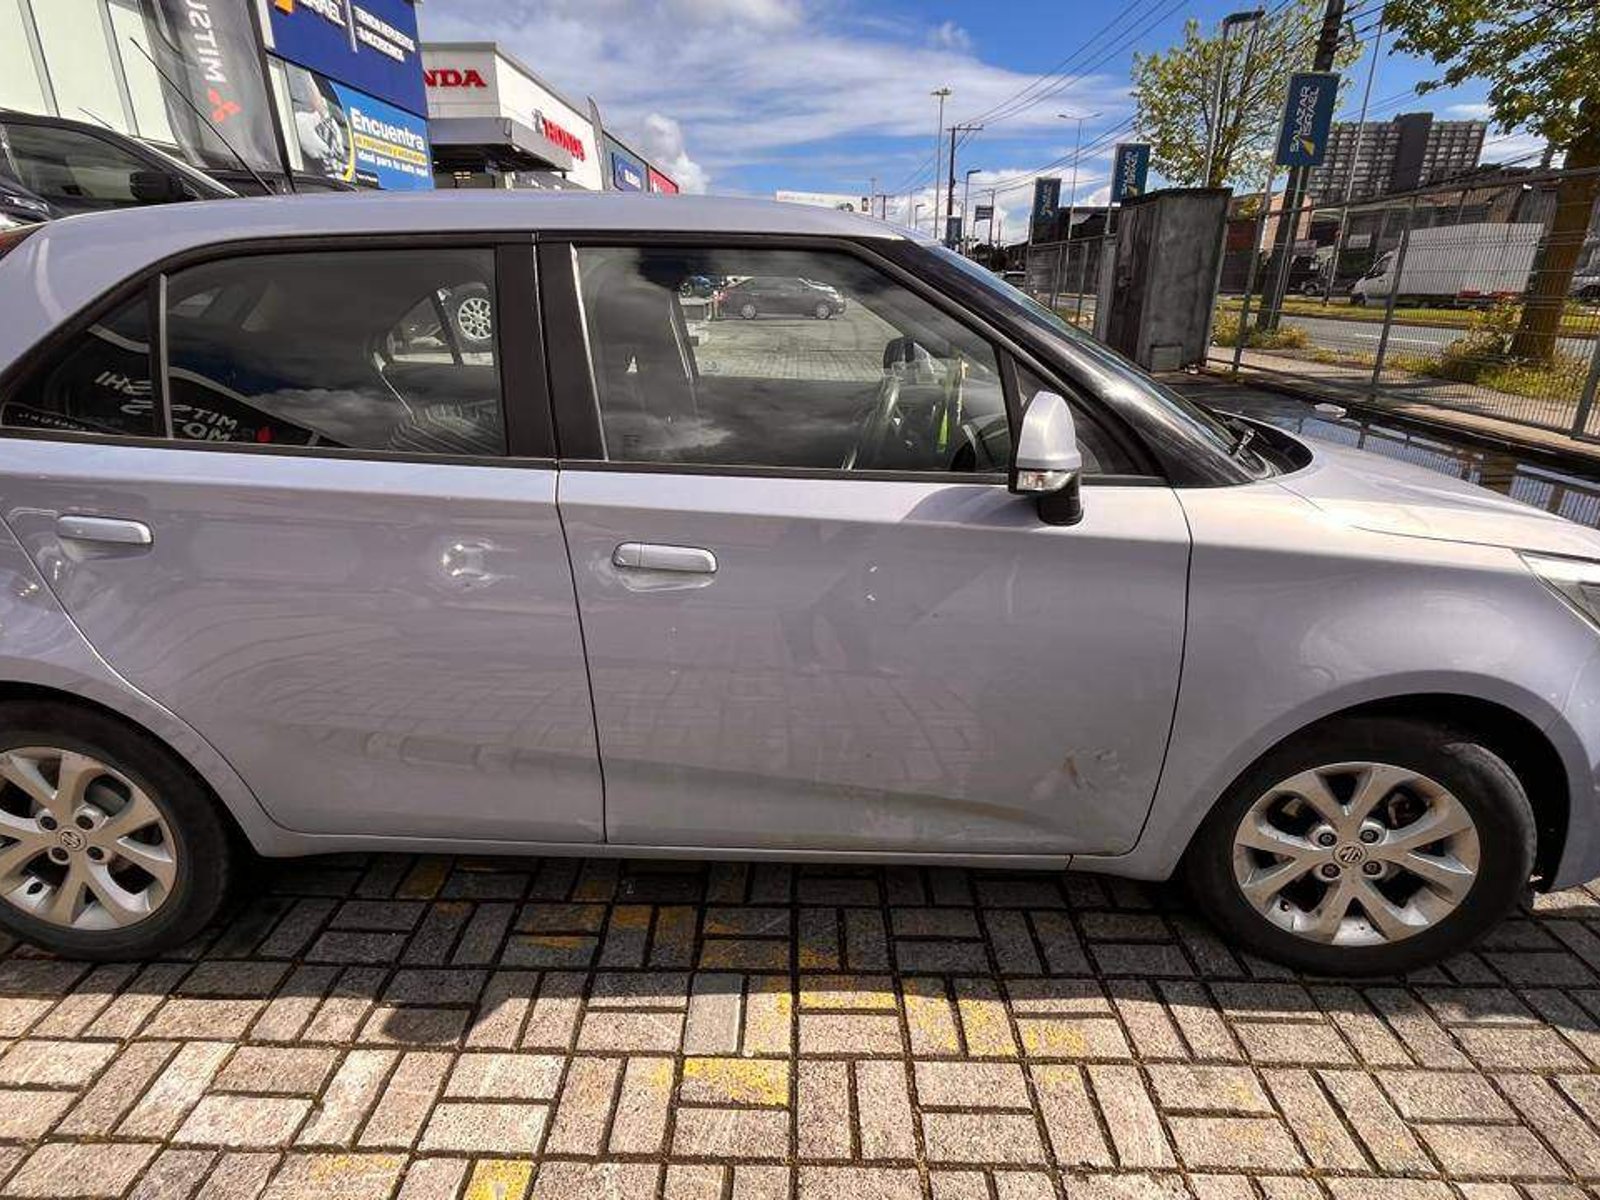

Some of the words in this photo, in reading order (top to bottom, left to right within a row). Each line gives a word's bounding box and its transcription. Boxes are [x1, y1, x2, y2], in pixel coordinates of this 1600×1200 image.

[350, 106, 425, 151] Encuentra
[1289, 86, 1311, 153] SALAZAR
[1301, 86, 1320, 136] ISRAEL
